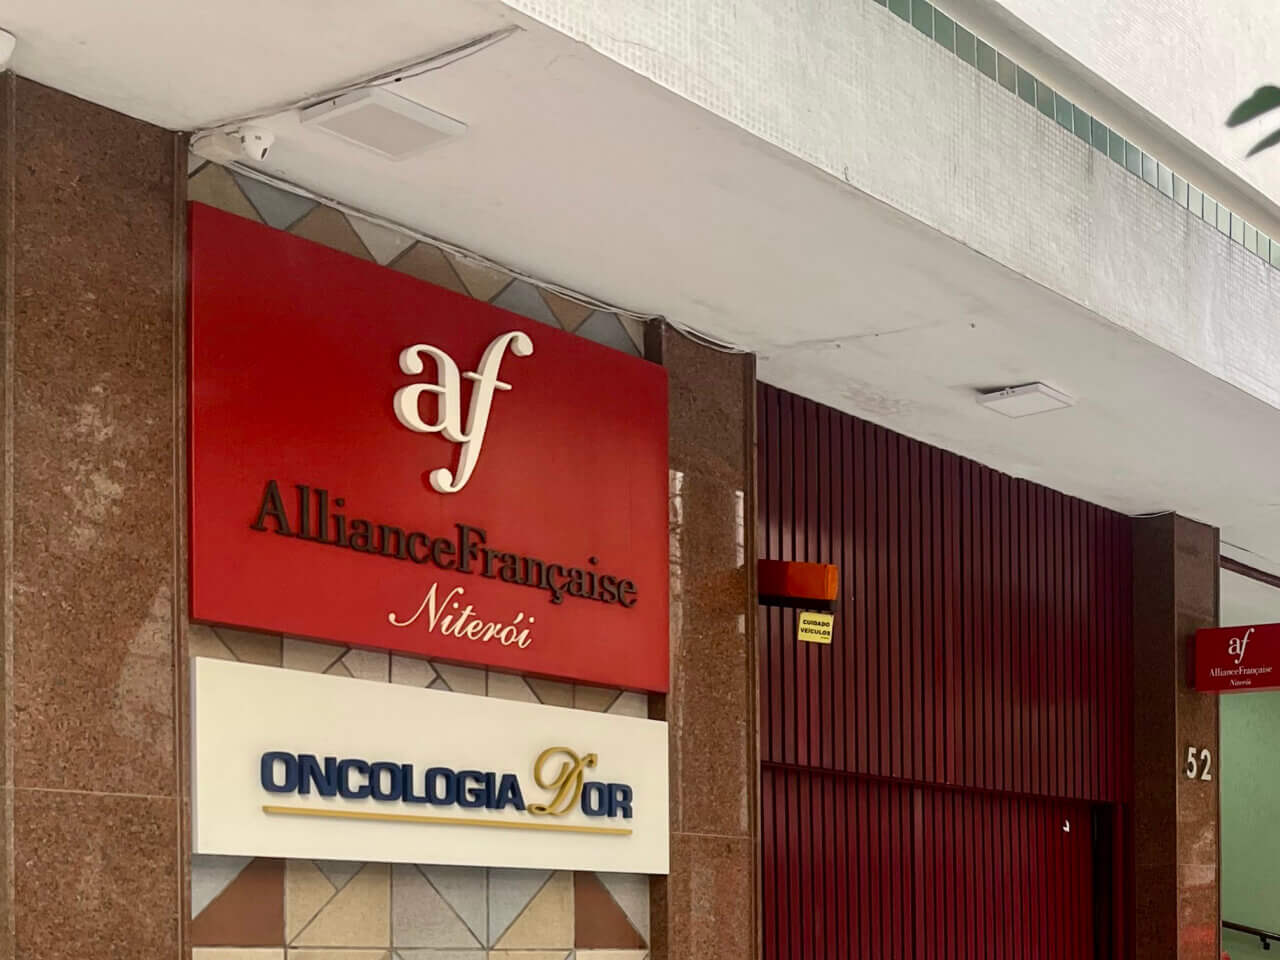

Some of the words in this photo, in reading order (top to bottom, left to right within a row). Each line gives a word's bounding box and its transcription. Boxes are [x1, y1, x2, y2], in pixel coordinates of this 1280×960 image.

[393, 331, 534, 494] af
[389, 582, 535, 649] Niterói
[803, 619, 830, 627] CUIDADO
[1228, 627, 1255, 664] af
[261, 751, 525, 812] ONCOLOGIA
[1186, 746, 1212, 781] 52
